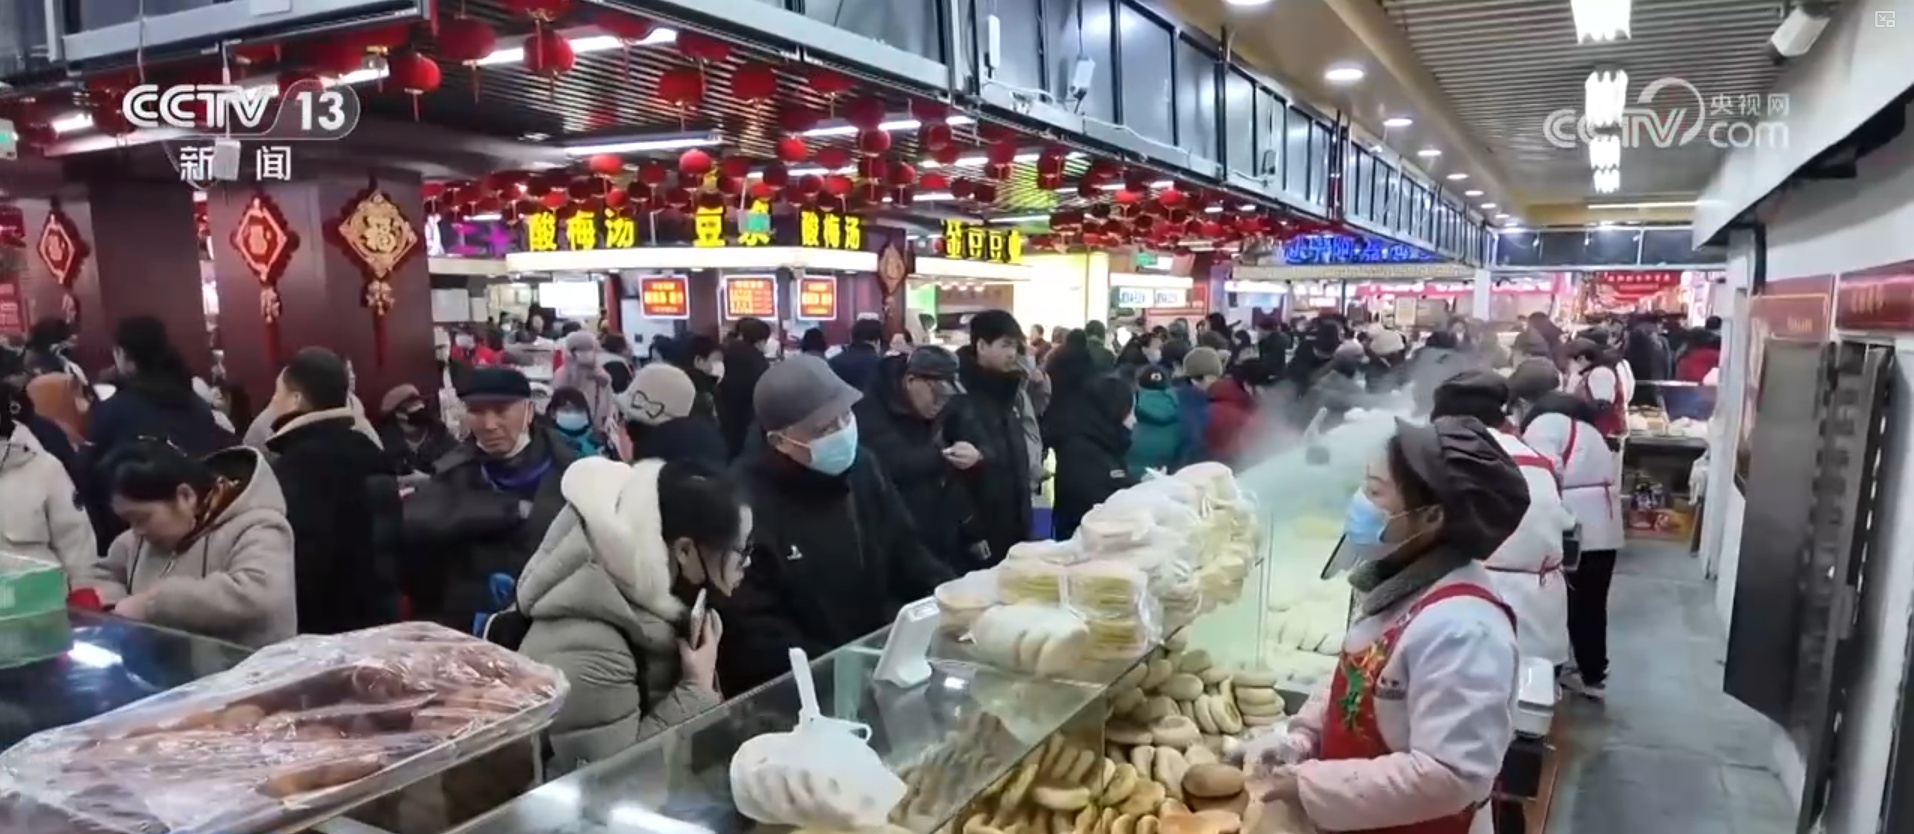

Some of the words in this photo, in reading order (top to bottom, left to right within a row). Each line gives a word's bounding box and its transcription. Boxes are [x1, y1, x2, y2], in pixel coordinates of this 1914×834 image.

[528, 207, 635, 252] 酸梅汤
[800, 210, 861, 250] 酸梅汤
